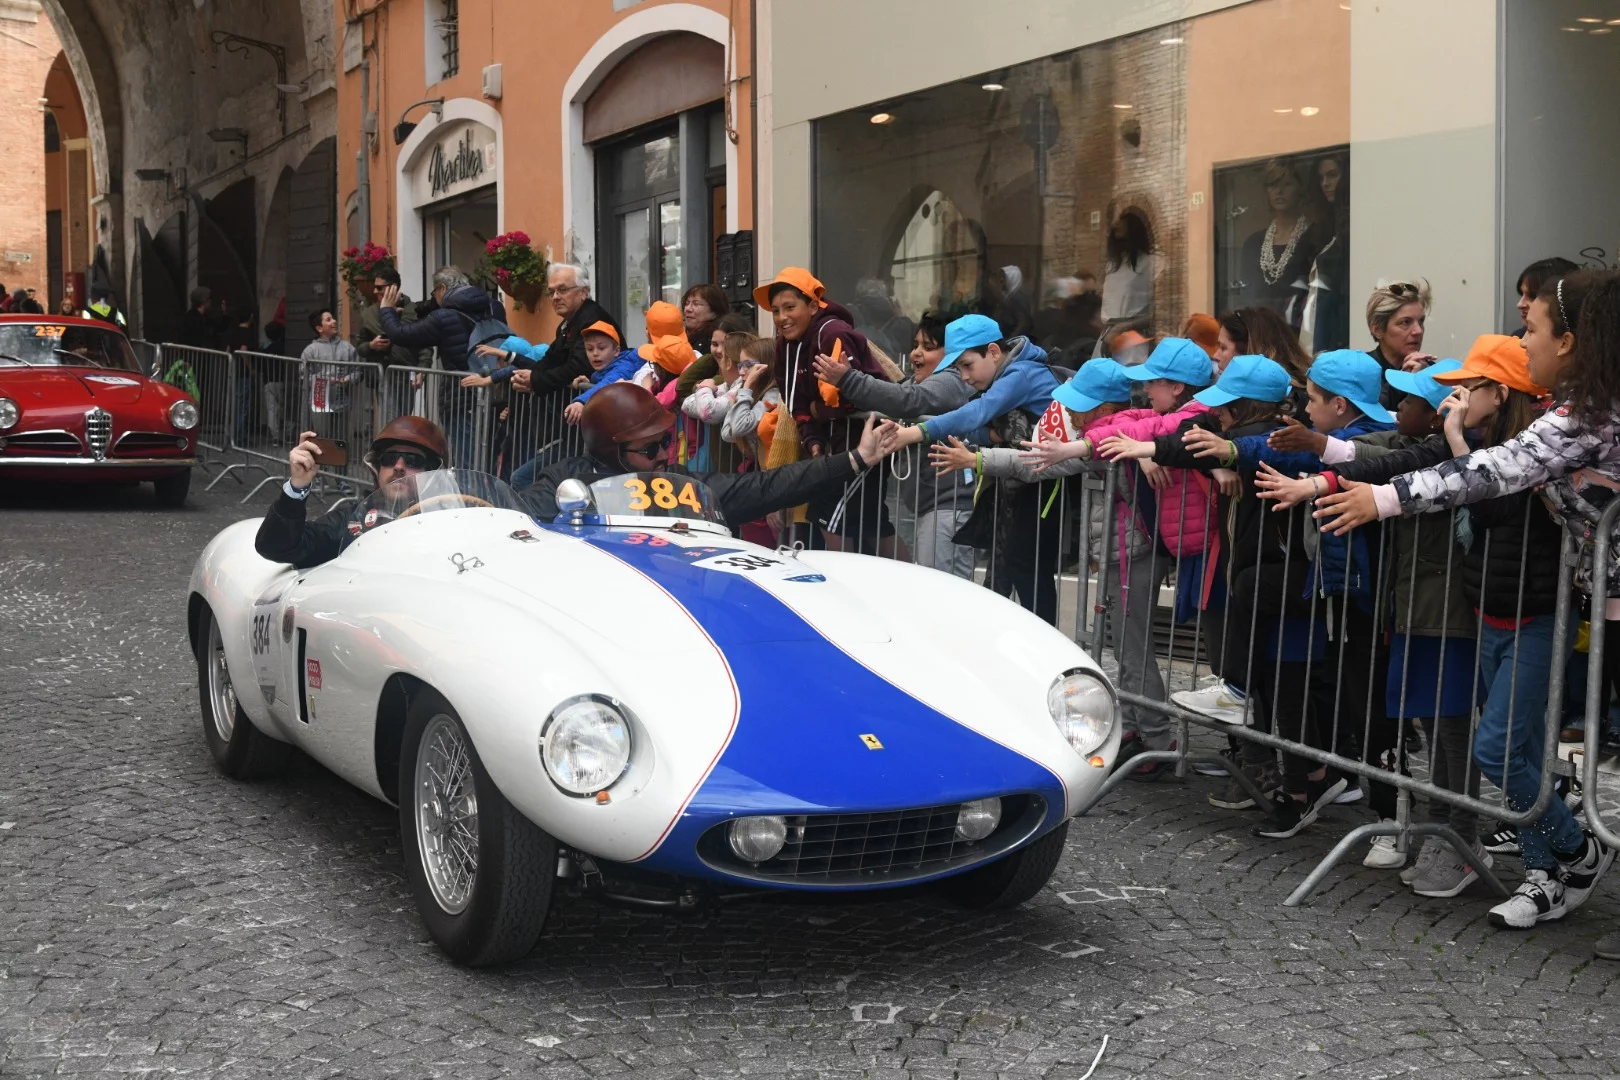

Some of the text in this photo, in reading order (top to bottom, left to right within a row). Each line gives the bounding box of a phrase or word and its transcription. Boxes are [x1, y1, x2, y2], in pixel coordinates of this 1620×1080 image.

[35, 325, 67, 338] 237
[623, 477, 702, 514] 384
[714, 554, 786, 571] 384
[253, 613, 271, 655] 384
